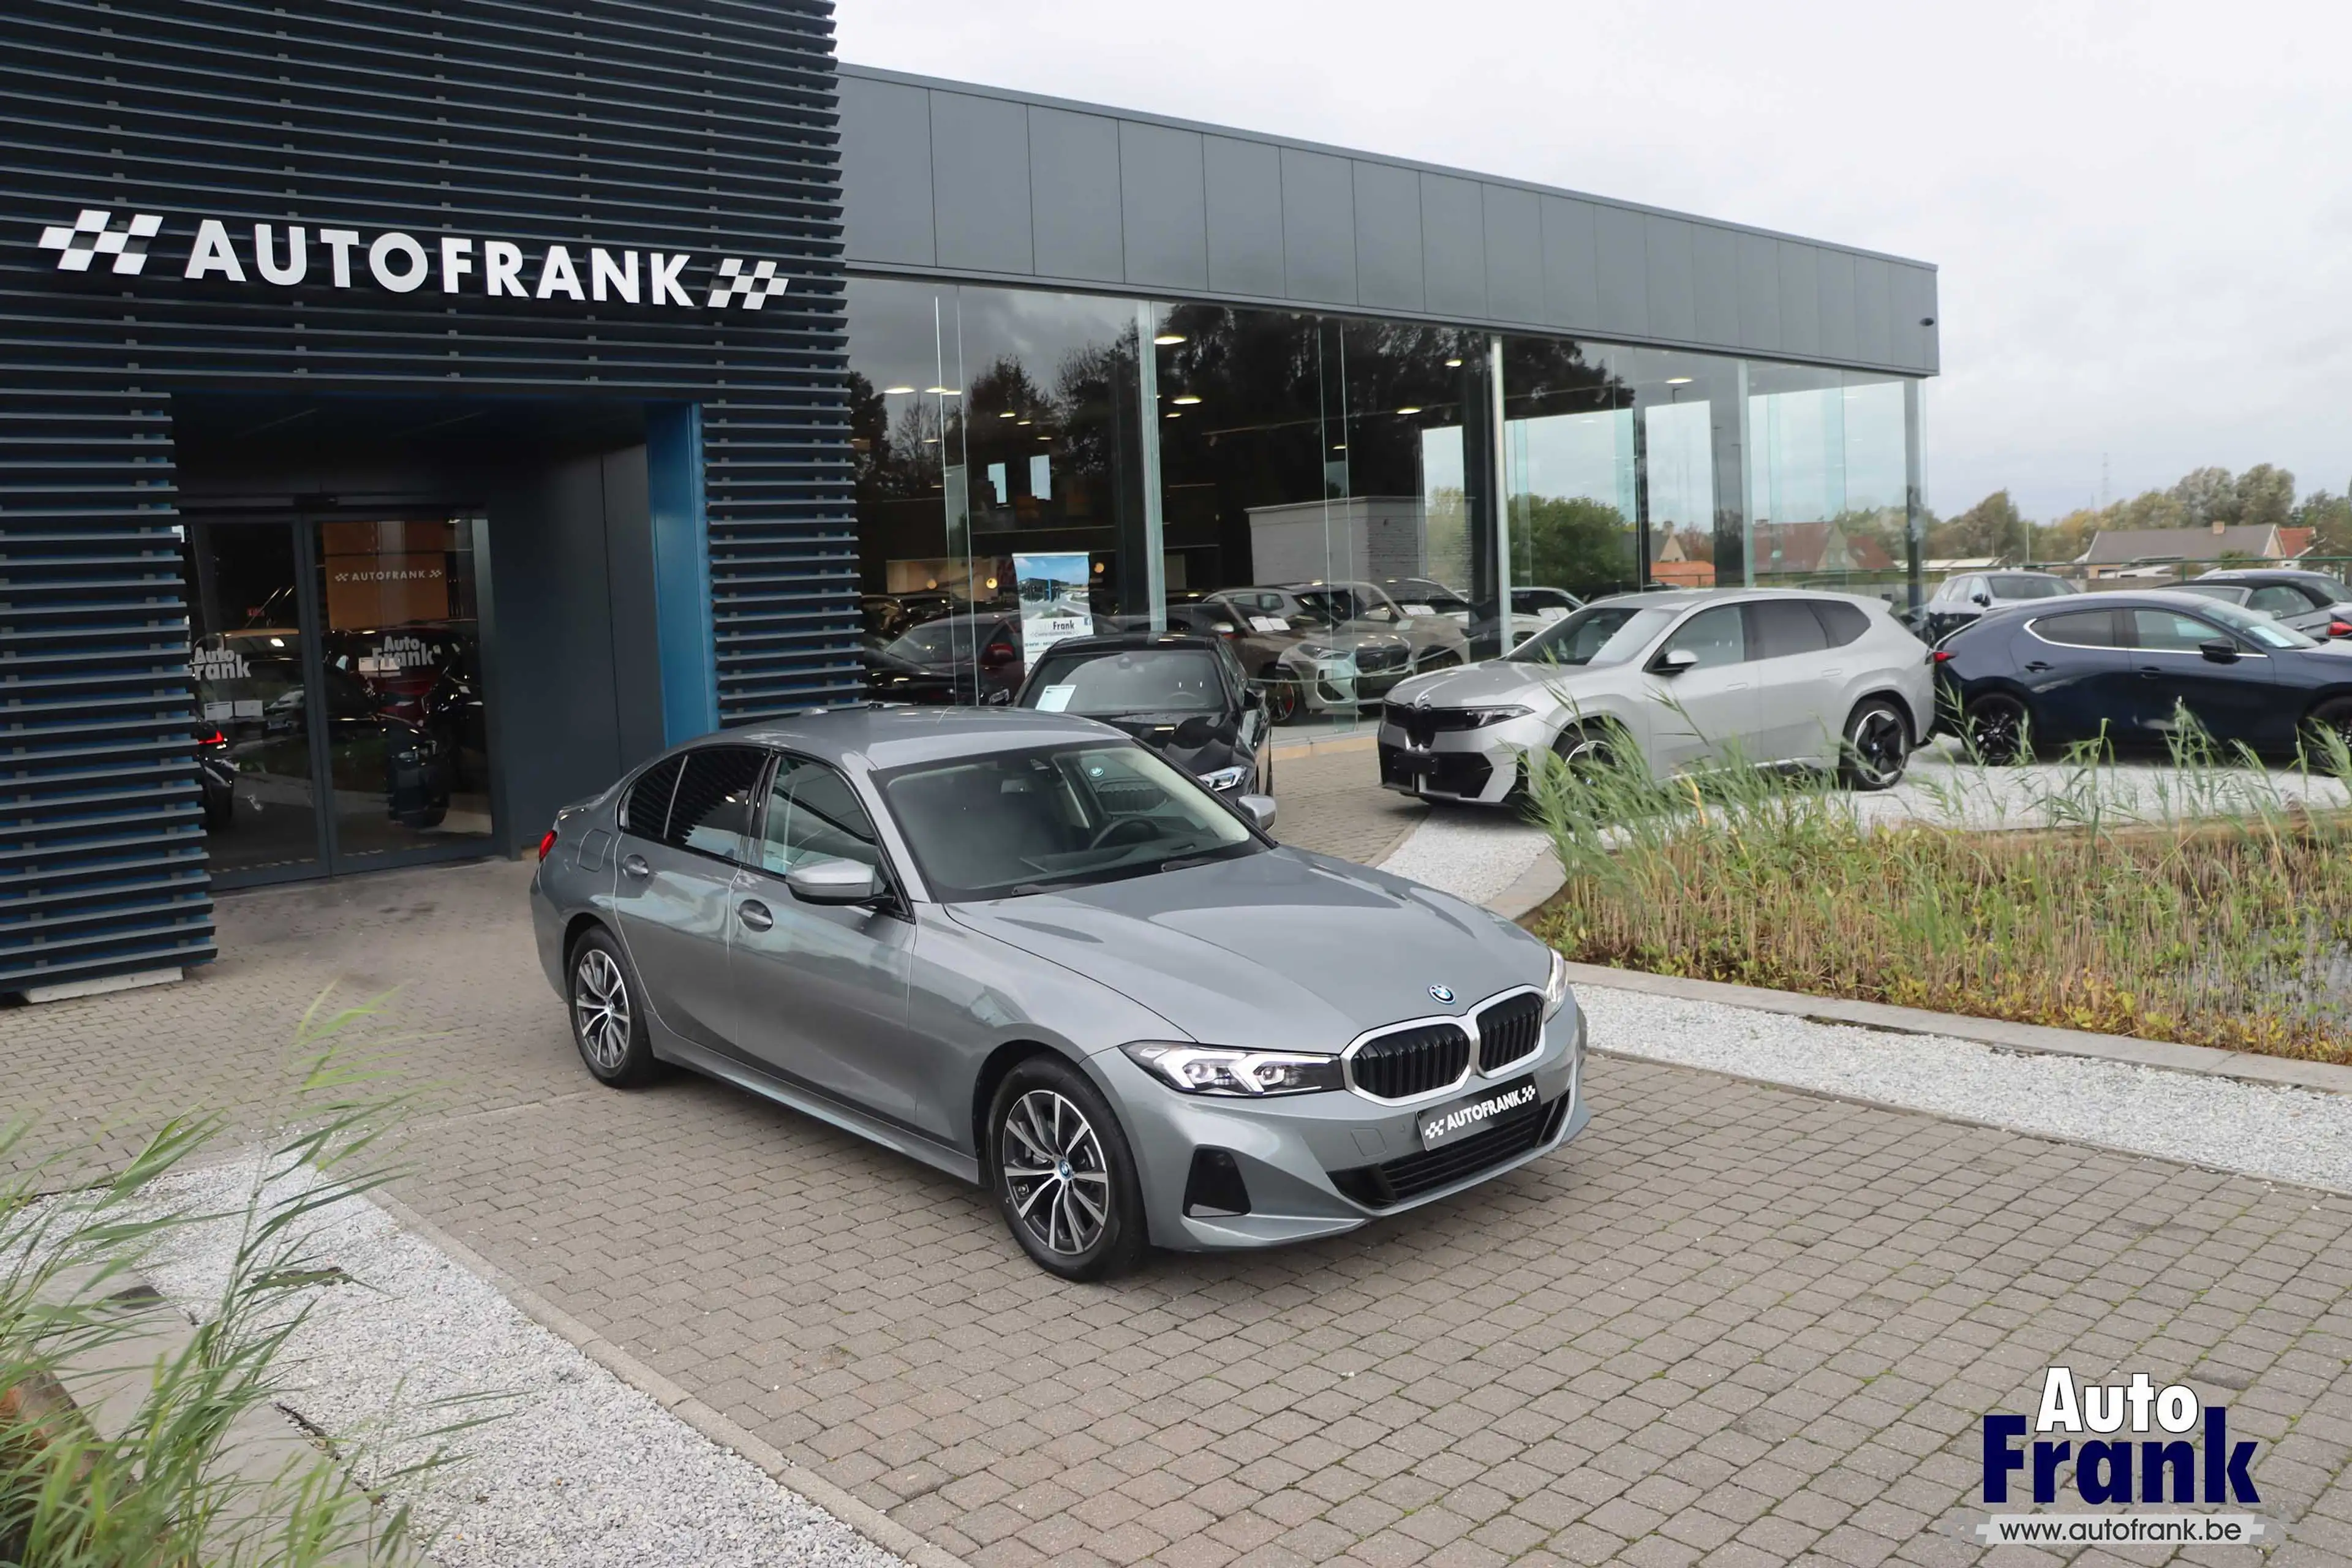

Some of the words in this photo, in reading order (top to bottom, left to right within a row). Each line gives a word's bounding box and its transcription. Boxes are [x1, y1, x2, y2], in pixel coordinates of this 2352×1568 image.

[184, 218, 695, 307] AUTOFRANK
[352, 570, 425, 581] AUTOFRANK
[1053, 620, 1074, 630] Frank
[384, 636, 420, 652] Auto
[194, 647, 235, 663] Auto
[372, 643, 434, 669] Frank
[1447, 1090, 1523, 1131] AUTOFRANK
